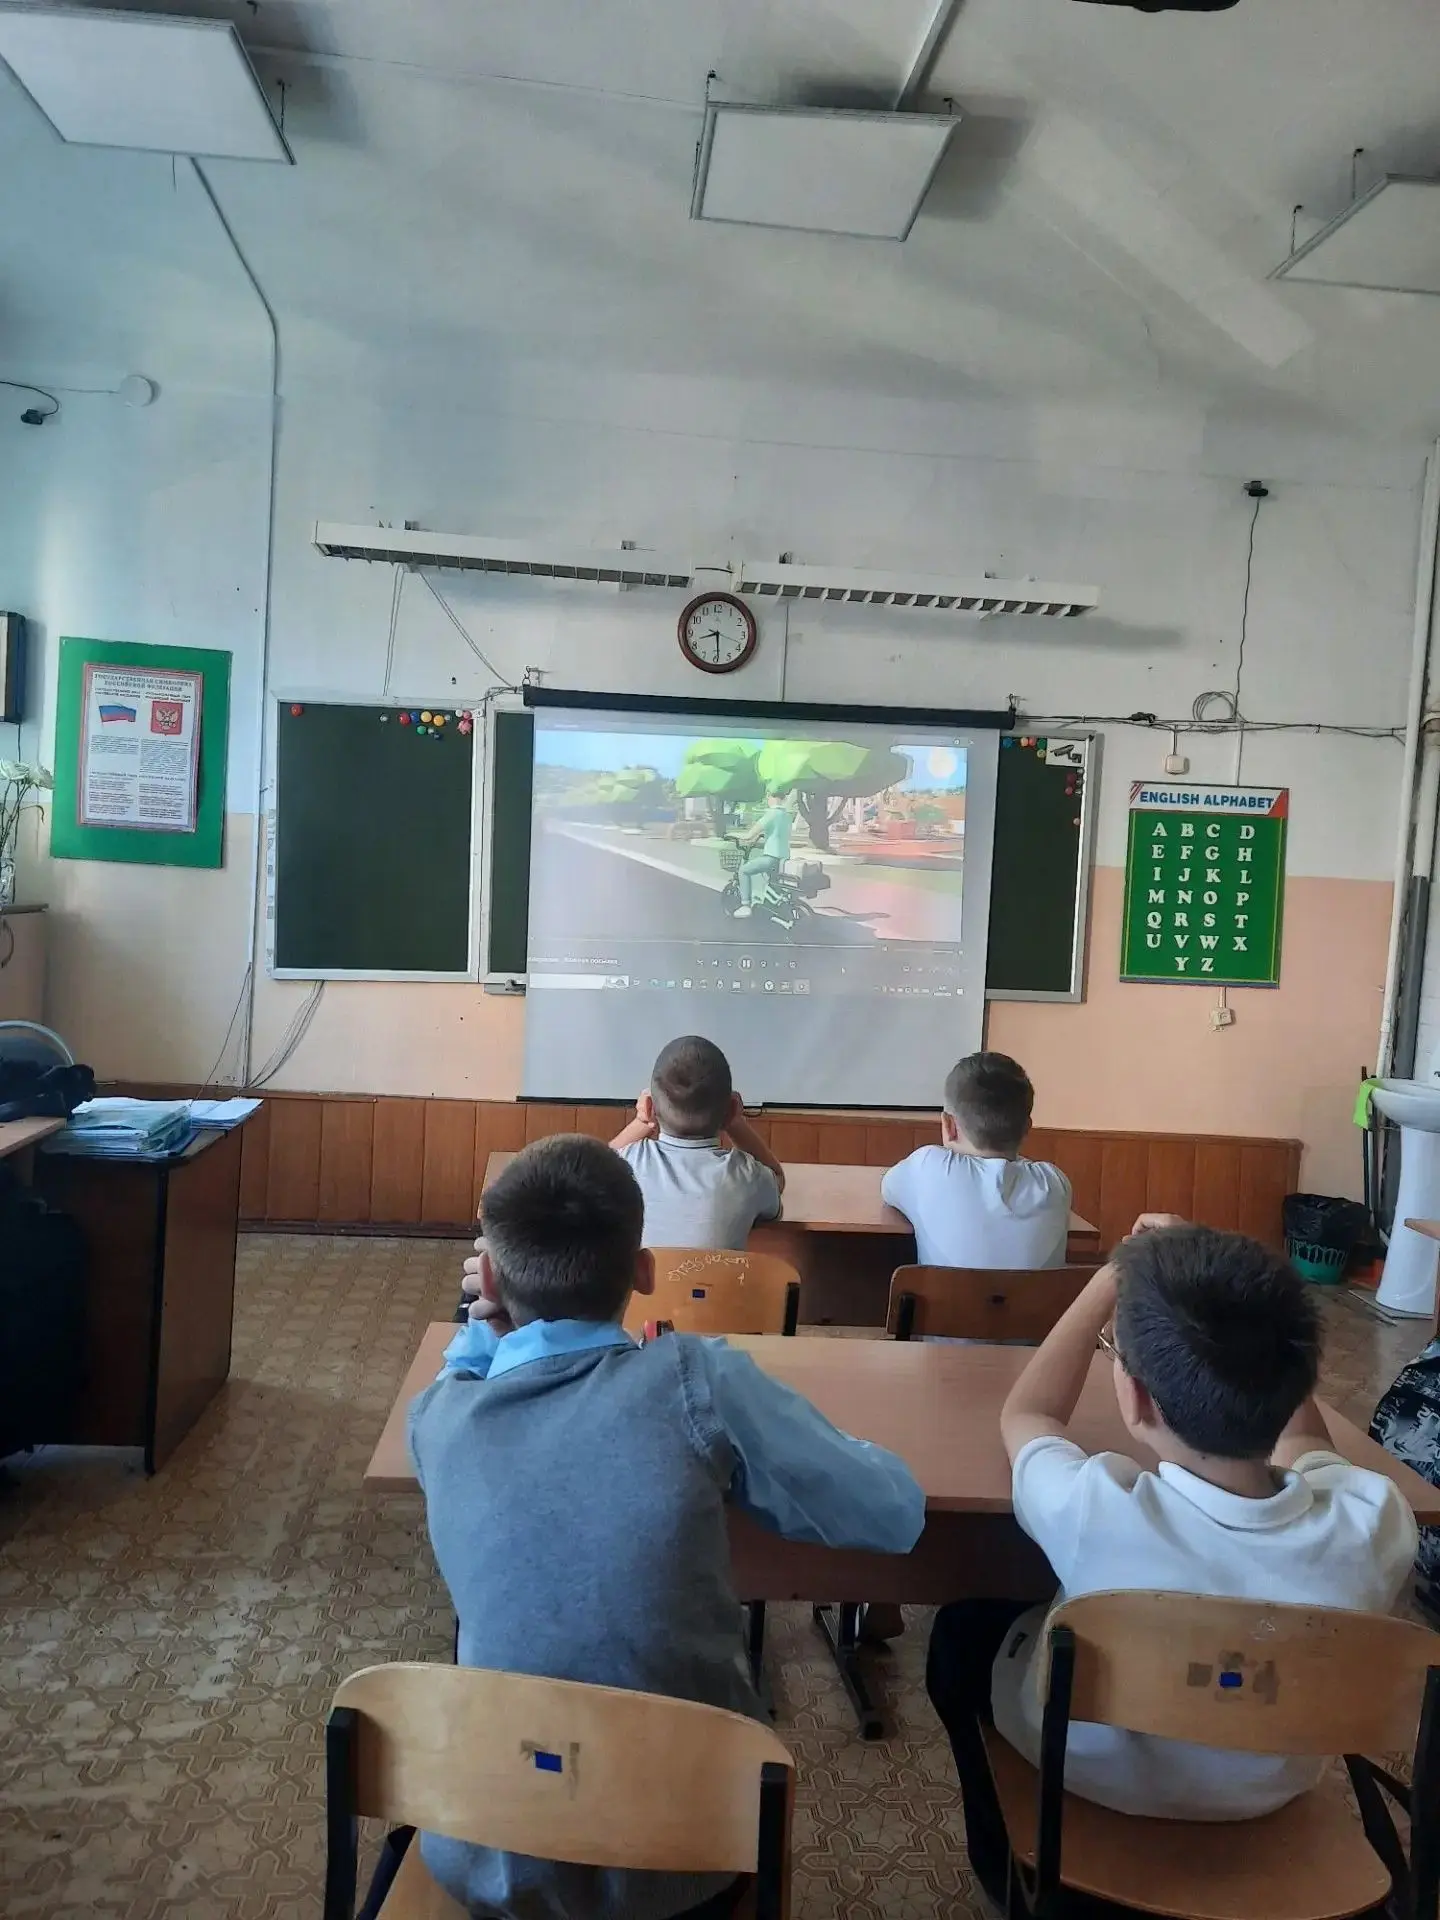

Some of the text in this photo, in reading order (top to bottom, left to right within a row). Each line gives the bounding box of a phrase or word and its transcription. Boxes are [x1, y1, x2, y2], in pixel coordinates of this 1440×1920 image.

[702, 607, 709, 616] 11
[713, 604, 723, 613] 12
[692, 615, 702, 625] 10
[736, 617, 743, 627] 2
[687, 629, 694, 638] 9
[740, 631, 746, 640] 3
[691, 640, 698, 650] 8
[726, 652, 732, 661] 5
[1139, 791, 1274, 809] ENGLISH ALPHABET
[1151, 823, 1255, 840] A B C D
[1151, 845, 1253, 862] E F G H
[1153, 867, 1252, 884] I J K L
[1148, 890, 1250, 906] M N O P
[1146, 912, 1249, 929] Q R S T
[1146, 934, 1248, 951] U V W X
[1174, 957, 1214, 972] Y Z
